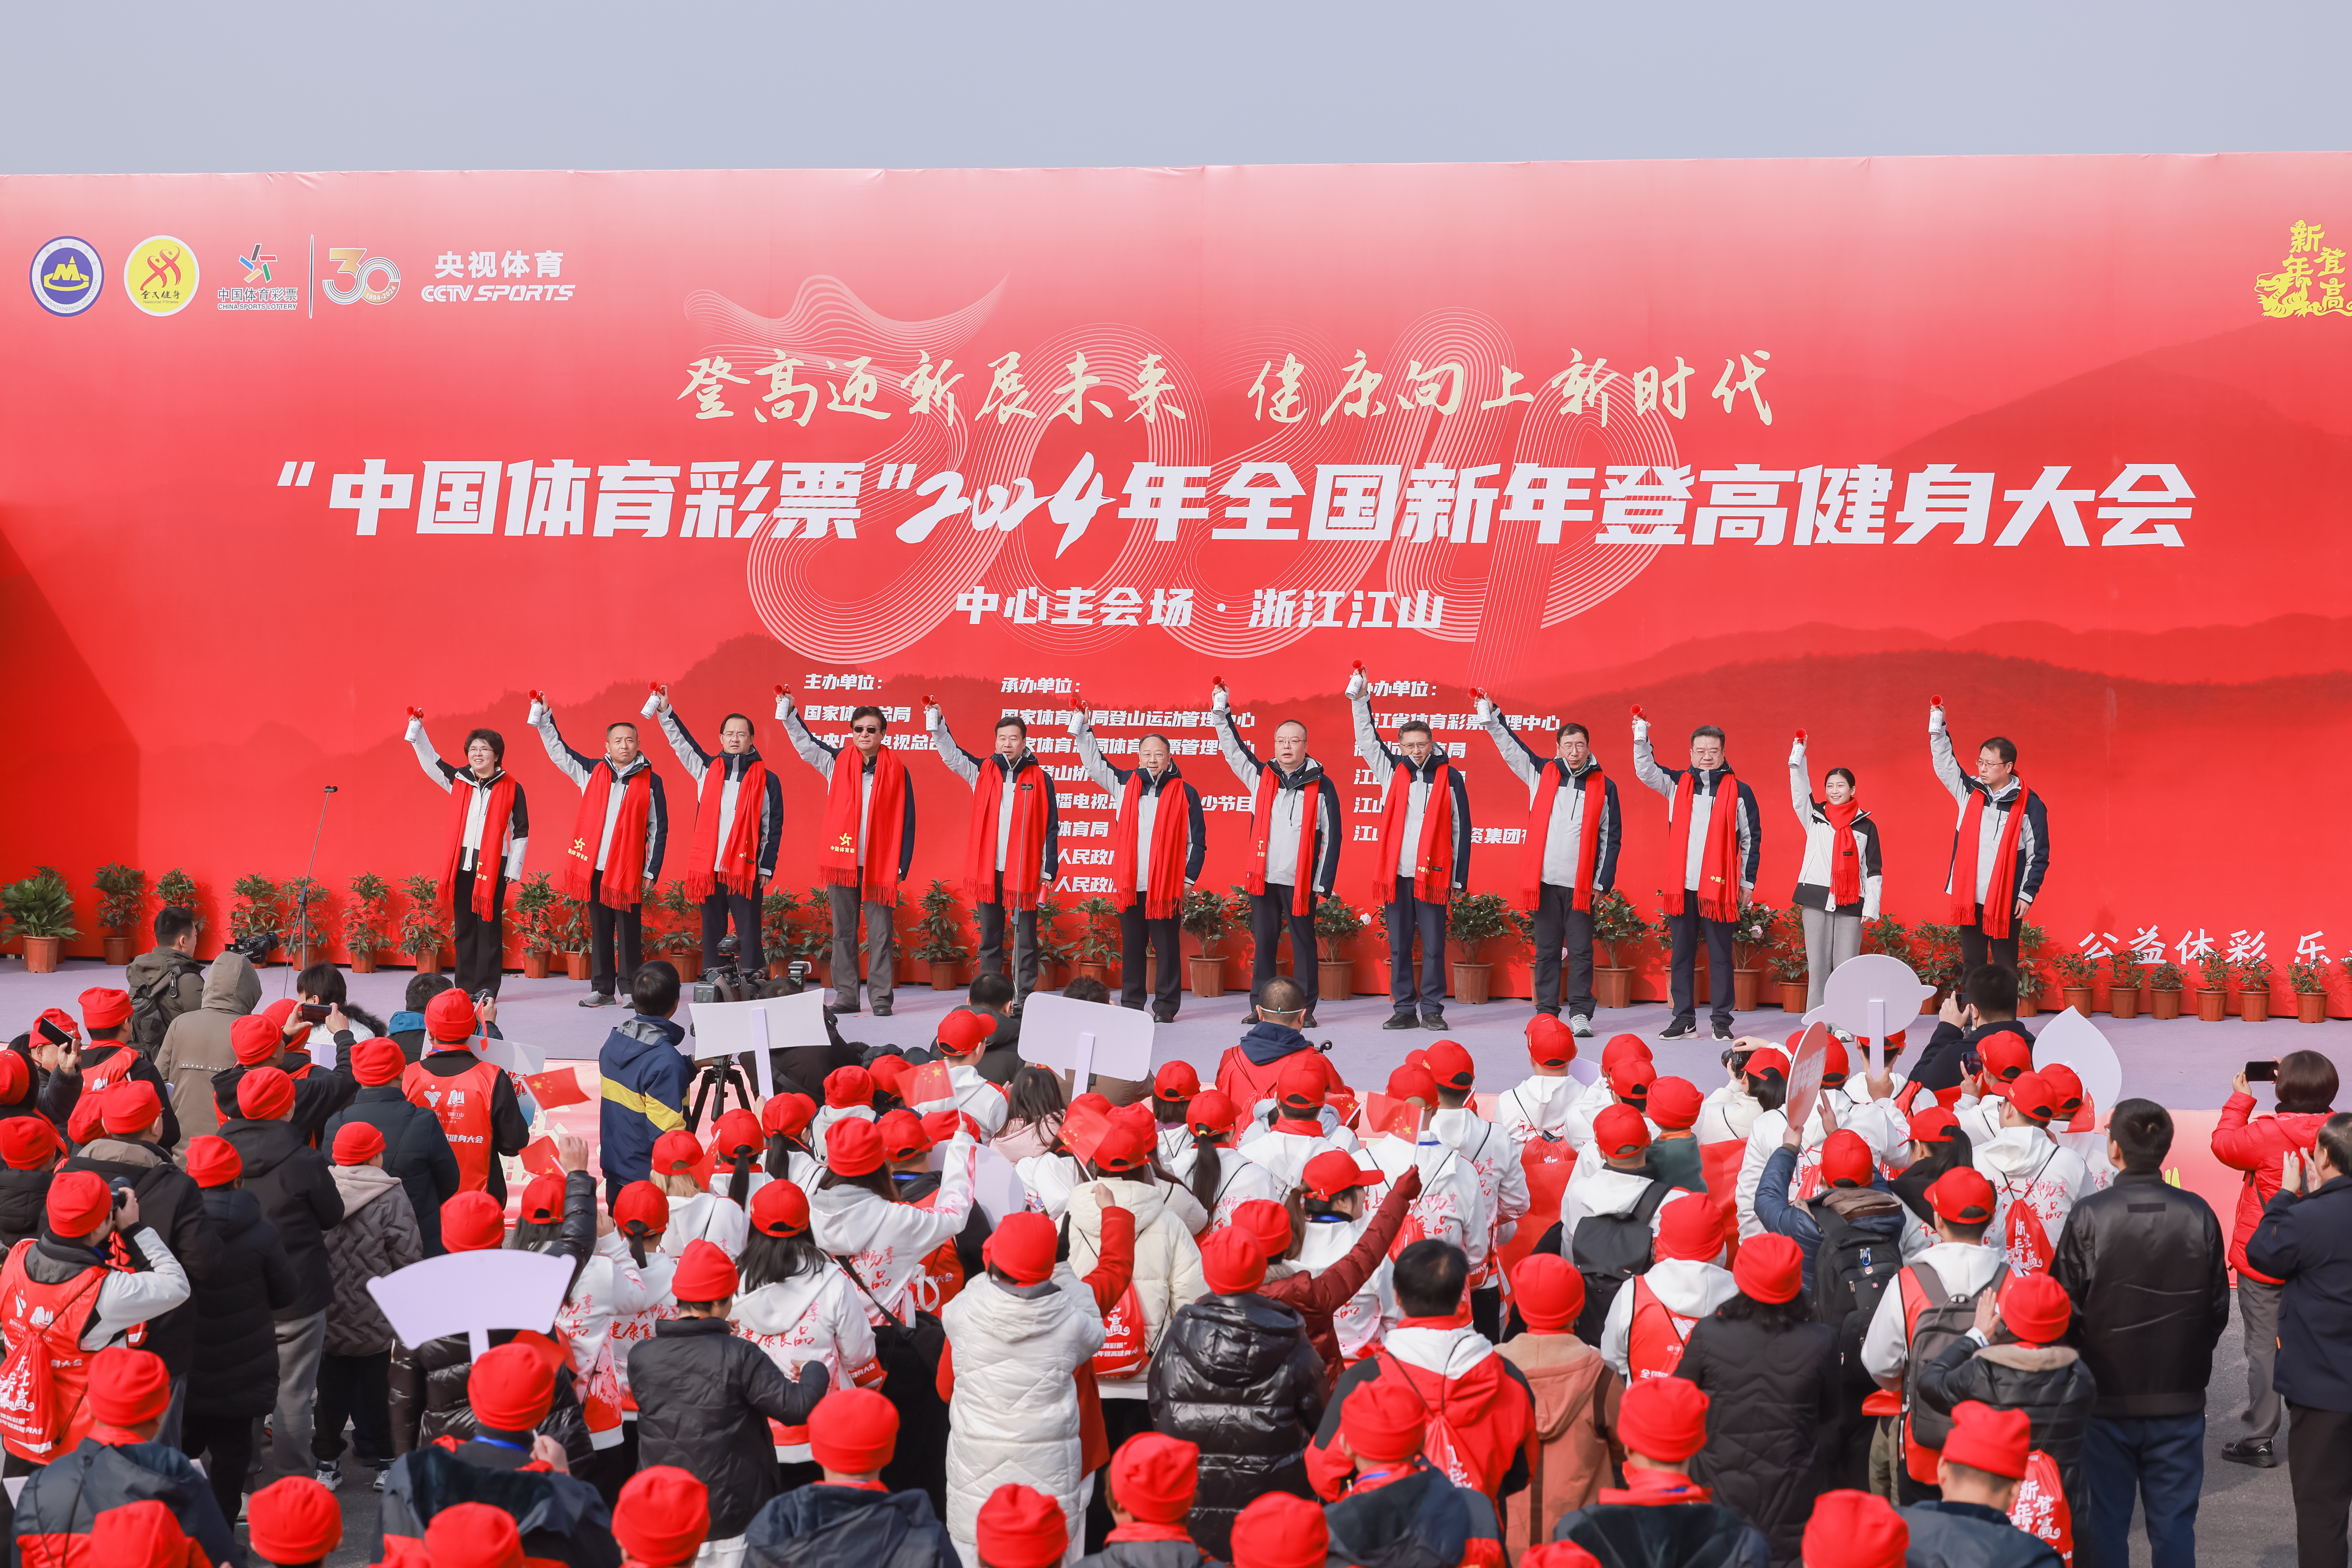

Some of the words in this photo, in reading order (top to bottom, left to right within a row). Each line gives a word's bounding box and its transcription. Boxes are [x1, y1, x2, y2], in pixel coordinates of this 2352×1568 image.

[37, 241, 98, 266] 中国登山协会
[434, 250, 564, 279] 央视体育
[36, 281, 45, 300] CHINESE
[44, 298, 81, 312] MOUNTAINEERING
[82, 279, 98, 306] ASSOCIATION
[140, 290, 181, 300] 全民健身
[218, 287, 298, 302] 中国体育彩票
[366, 284, 396, 301] 1994-2024
[421, 284, 474, 302] CCTV
[473, 284, 576, 301] SPORTS
[677, 348, 1186, 426] 登高迎新展未来
[1247, 348, 1773, 427] 健康向上新时代
[804, 674, 883, 690] 主办单位：
[1001, 677, 1080, 694] 承办单位：
[804, 705, 911, 722] 国家体总局
